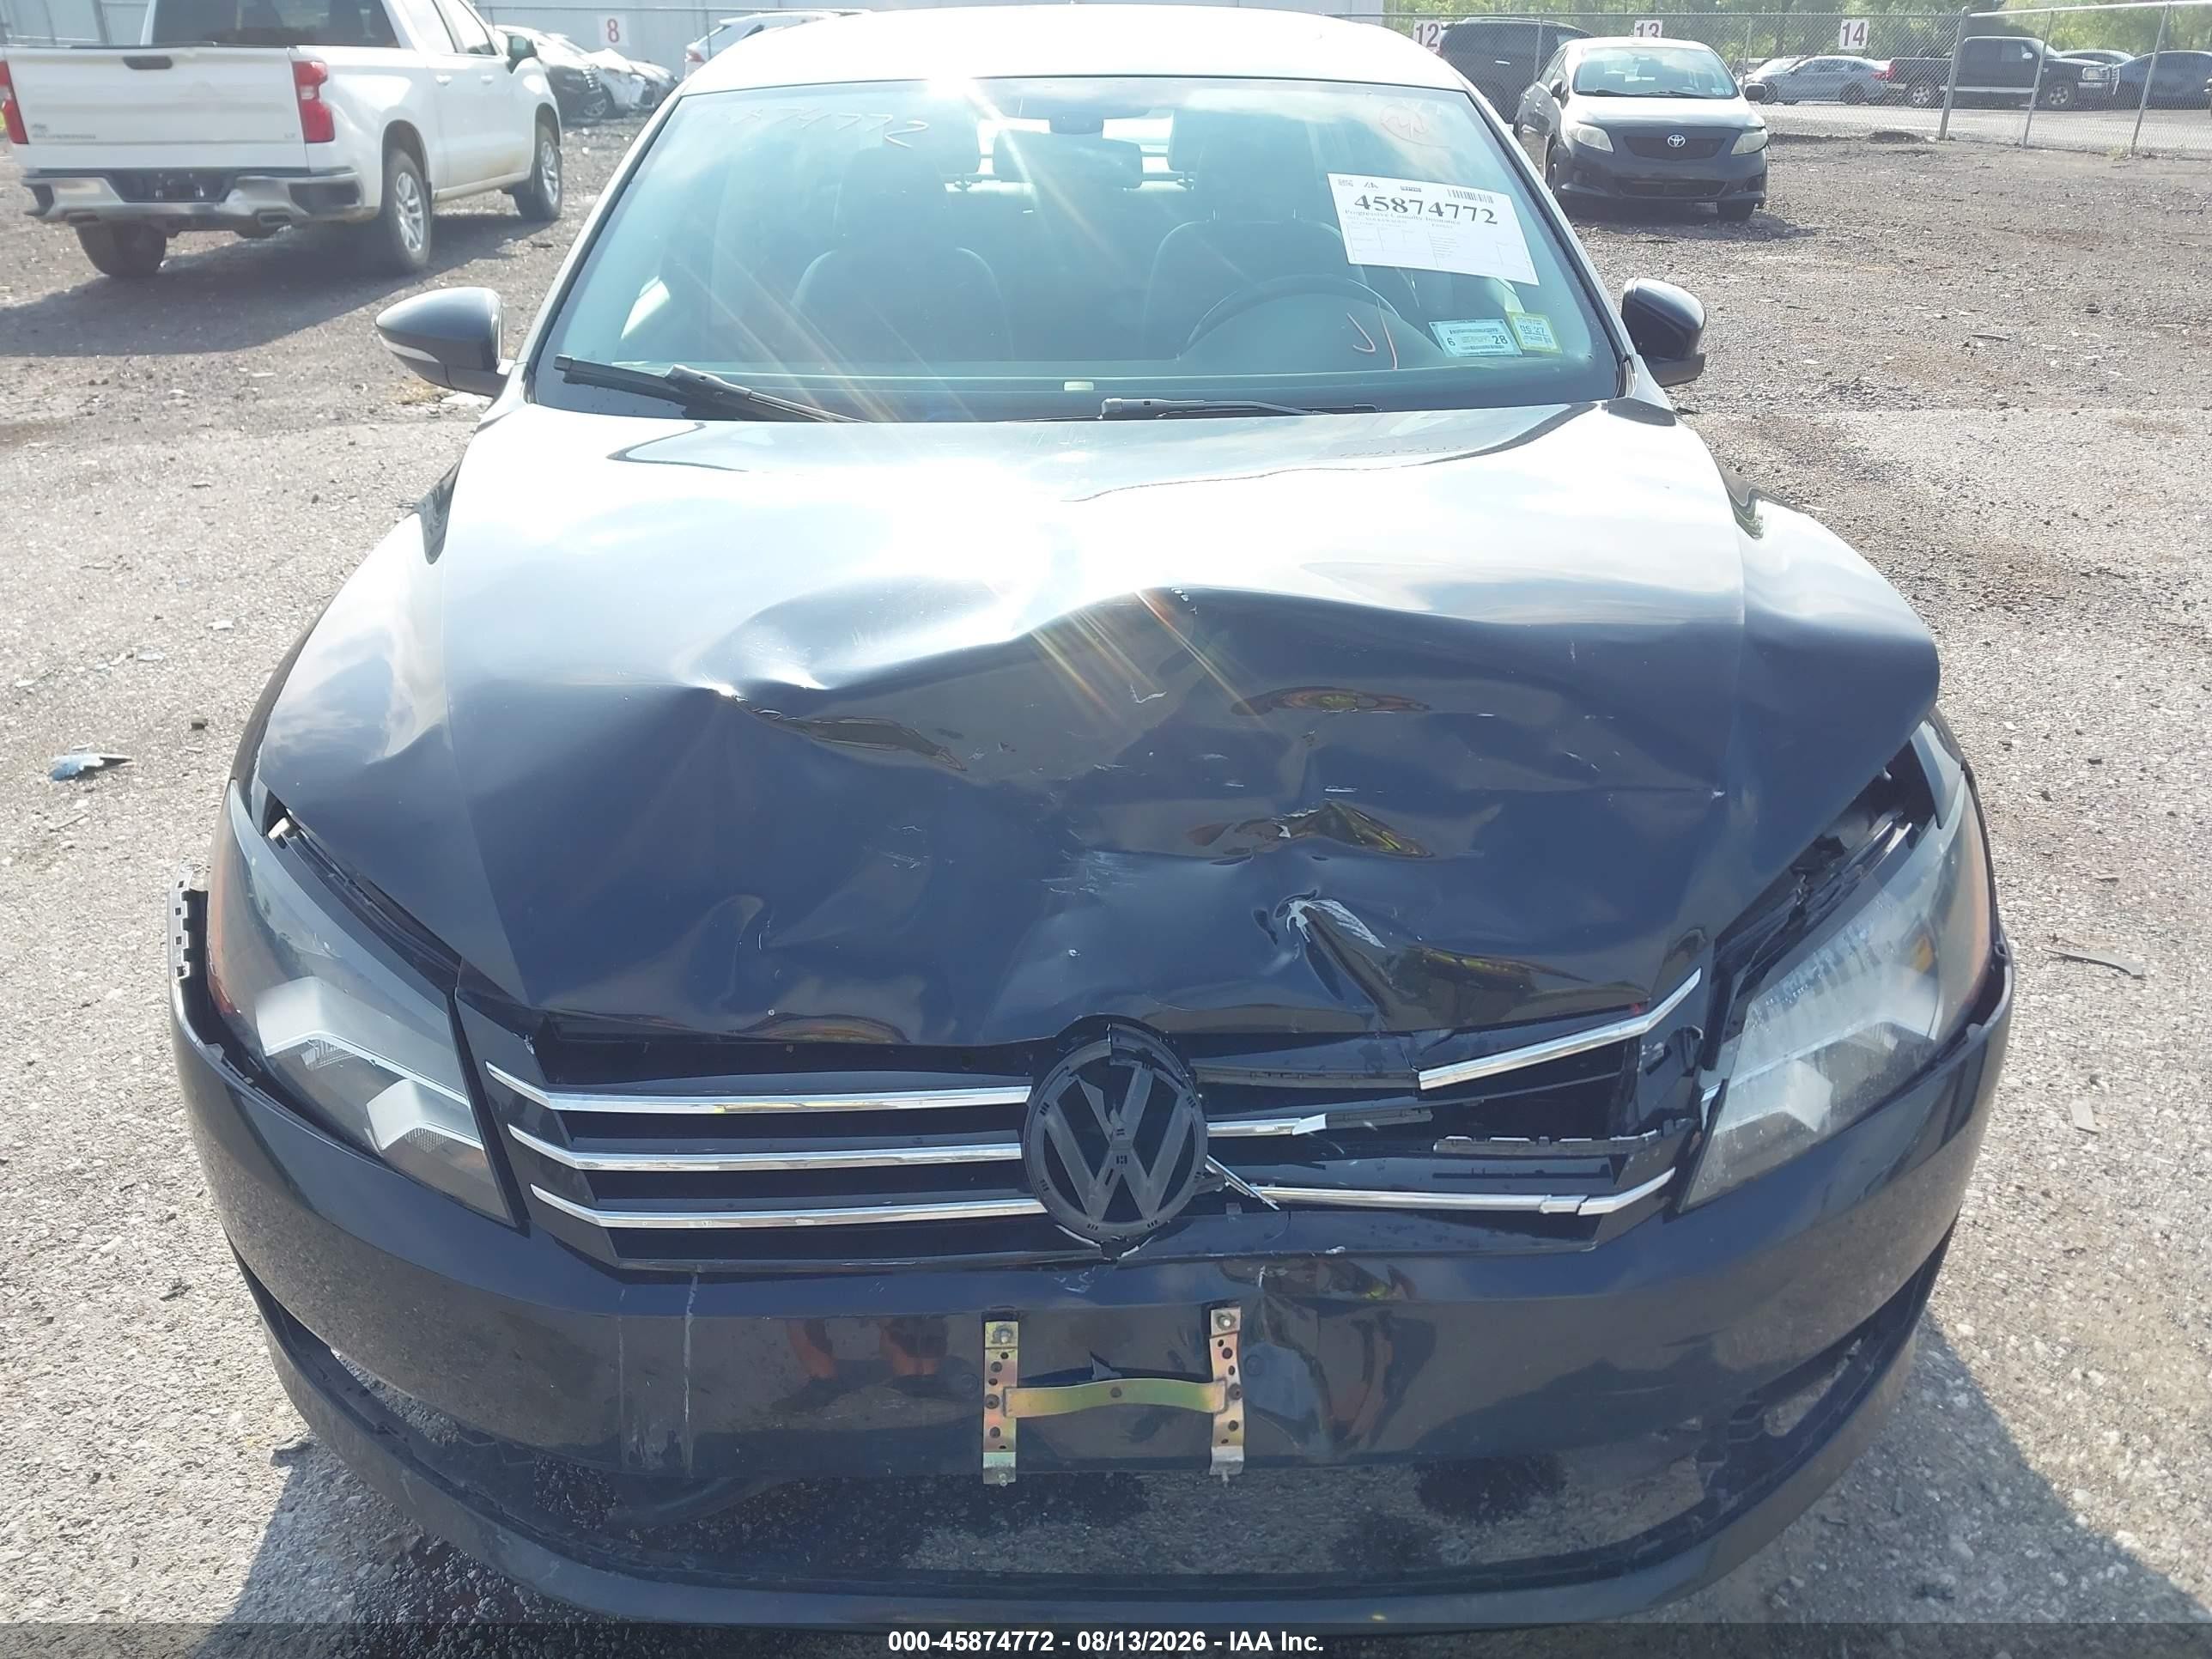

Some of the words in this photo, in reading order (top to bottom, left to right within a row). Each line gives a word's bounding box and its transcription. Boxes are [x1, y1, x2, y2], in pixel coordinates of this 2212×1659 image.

[607, 18, 619, 43] 8
[1416, 22, 1439, 47] 12
[1842, 21, 1865, 46] 14
[1354, 194, 1498, 225] 45874772
[1447, 337, 1456, 346] 6
[1492, 335, 1509, 344] 28
